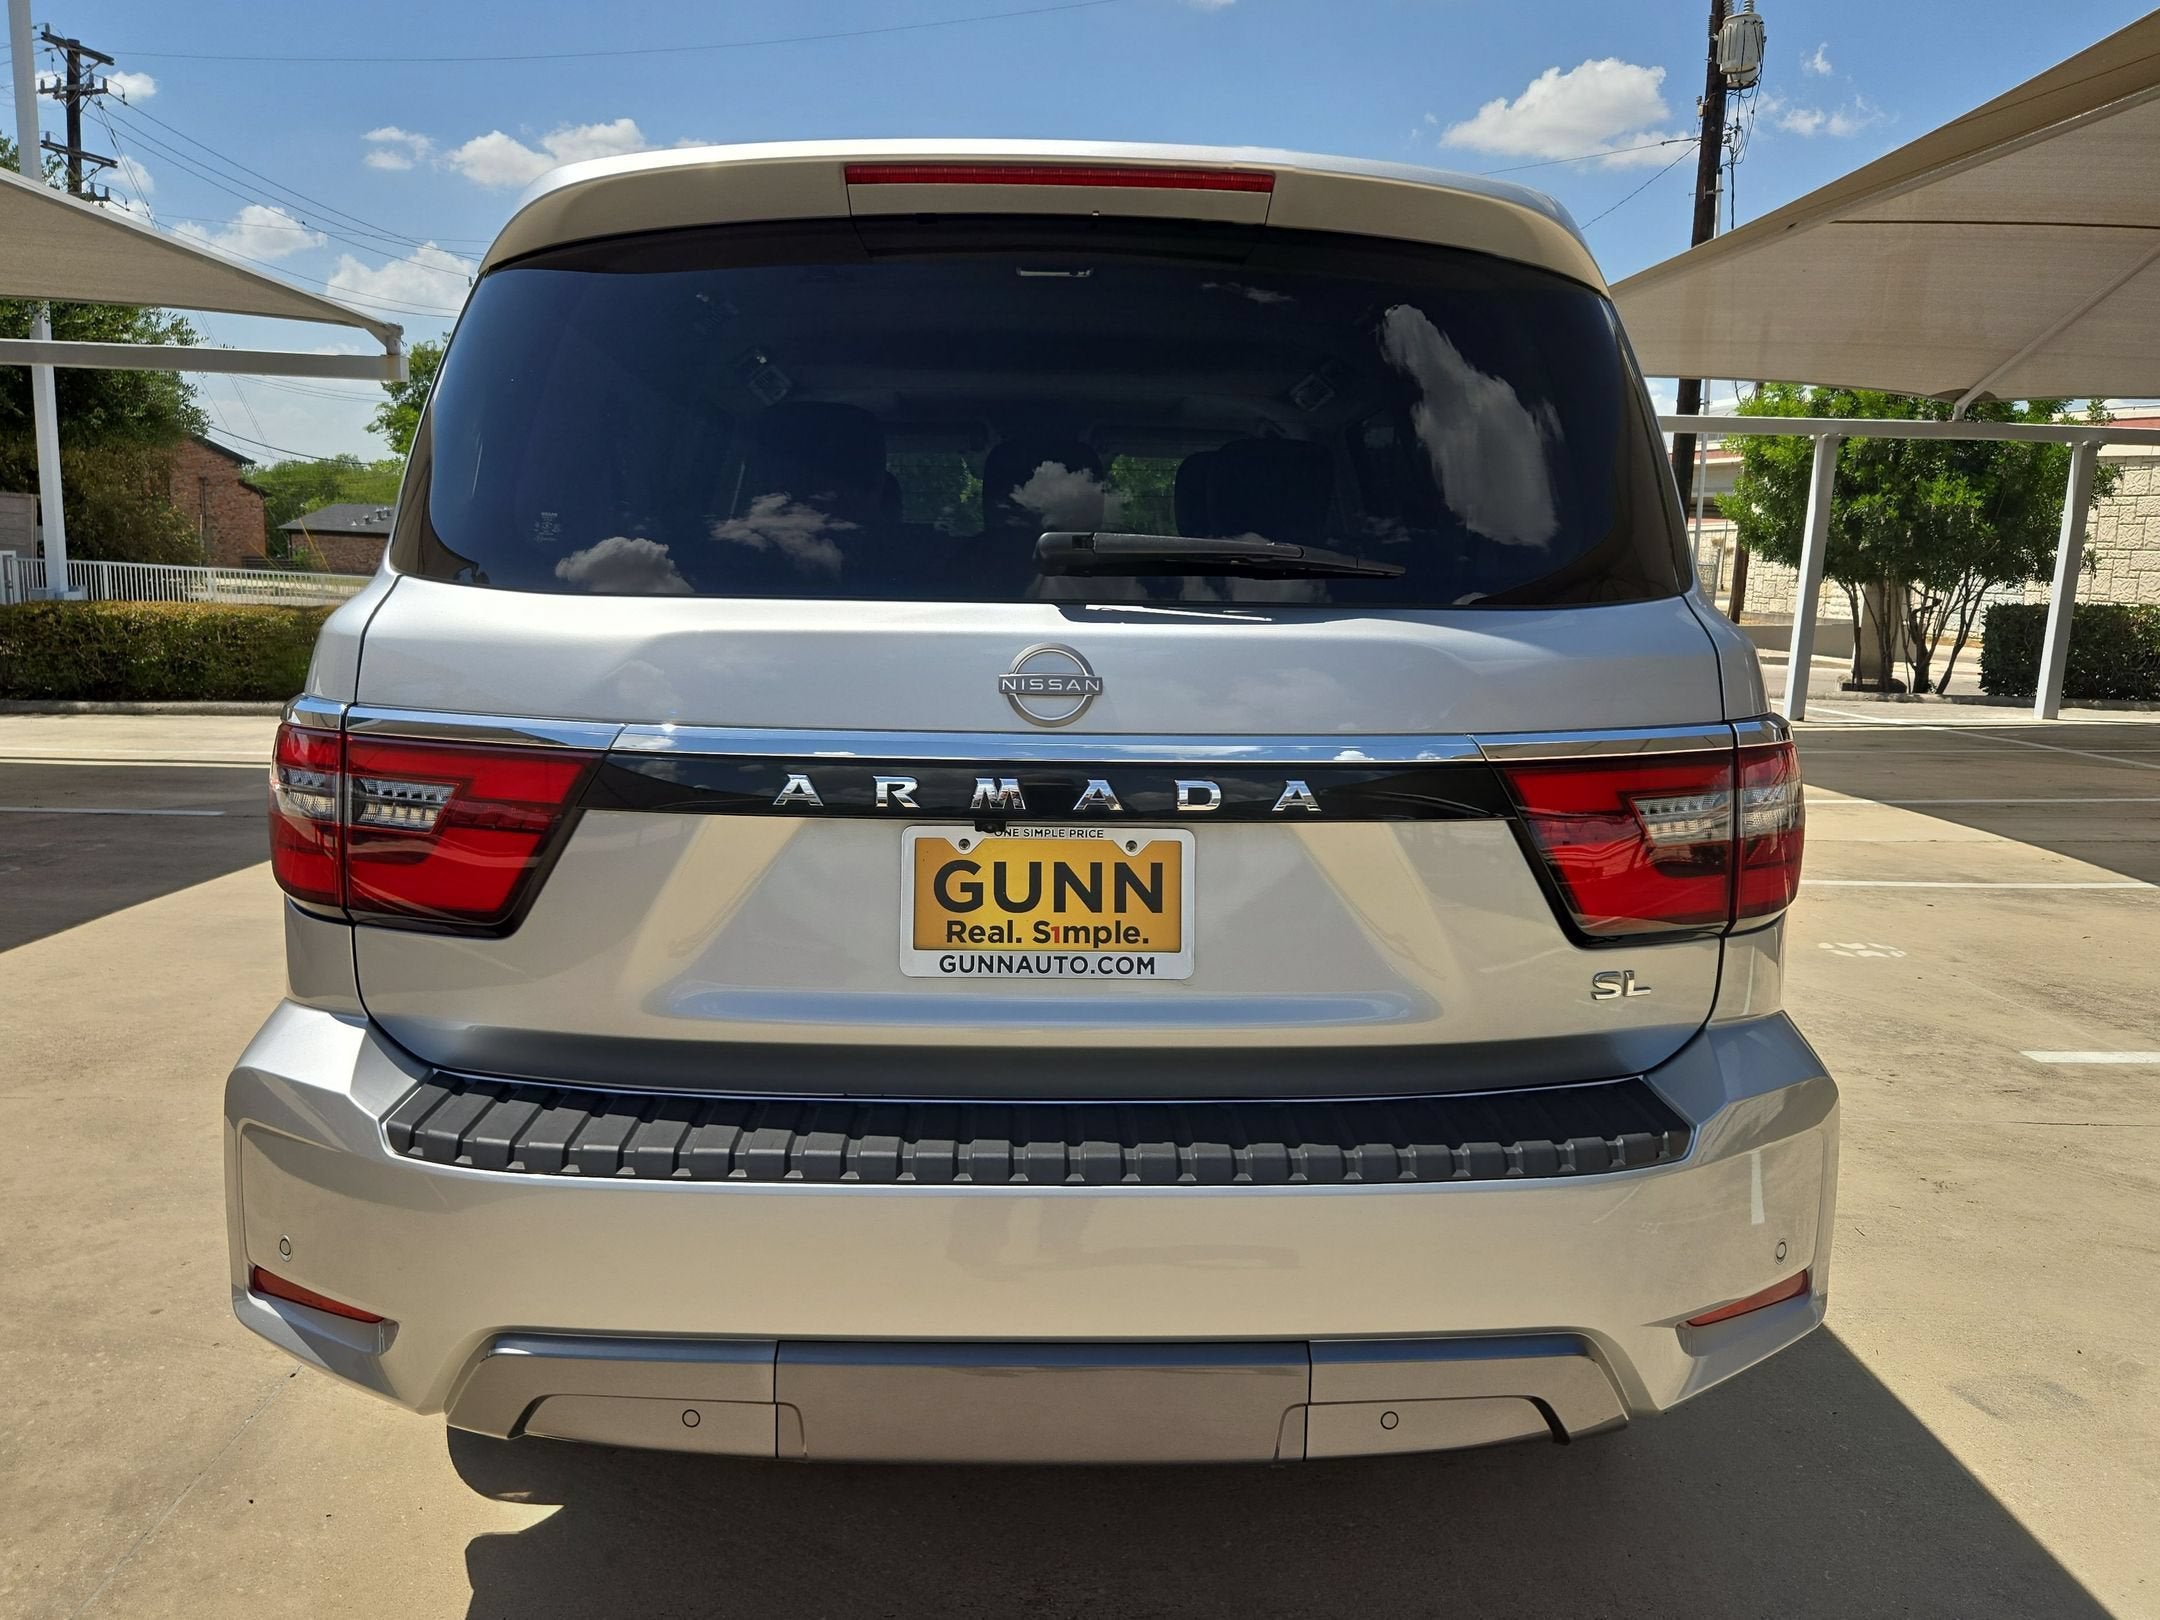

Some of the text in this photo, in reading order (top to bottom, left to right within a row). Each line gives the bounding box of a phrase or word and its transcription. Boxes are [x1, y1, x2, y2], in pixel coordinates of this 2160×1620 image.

[1001, 678, 1100, 692] NISSAN
[772, 773, 1322, 812] ARMADA
[1023, 828, 1066, 839] SIMPLE
[1069, 829, 1104, 839] PRICE
[933, 859, 1163, 914] GUNN
[945, 919, 1022, 945] Real.
[938, 954, 1155, 976] GUNNAUTO.COM
[1591, 969, 1652, 1001] SL
